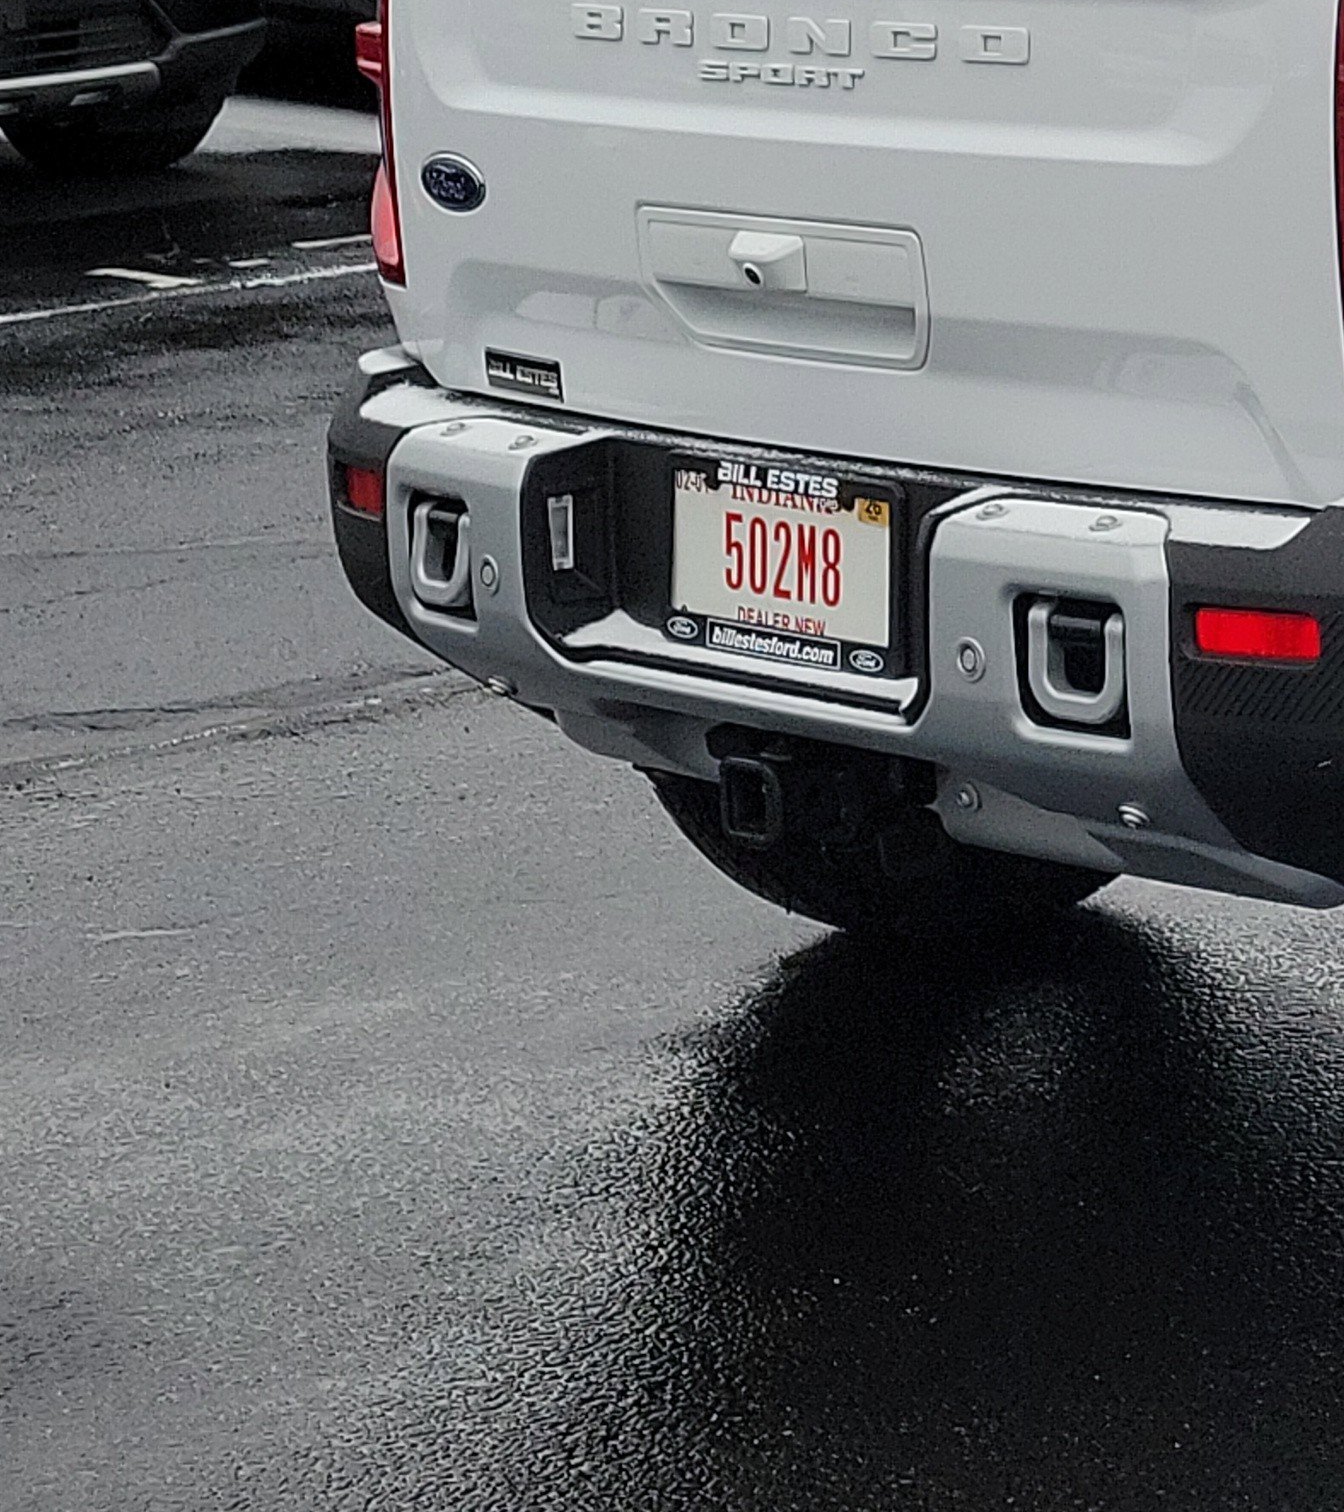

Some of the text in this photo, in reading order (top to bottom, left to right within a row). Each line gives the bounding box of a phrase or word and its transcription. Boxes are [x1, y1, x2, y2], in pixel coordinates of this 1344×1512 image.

[570, 2, 1031, 65] BRONCO
[697, 59, 864, 90] SPORT
[718, 460, 838, 498] BILL ESTES
[724, 511, 841, 608] 502M8
[712, 625, 835, 664] billestesford.com
[795, 617, 826, 635] NEW
